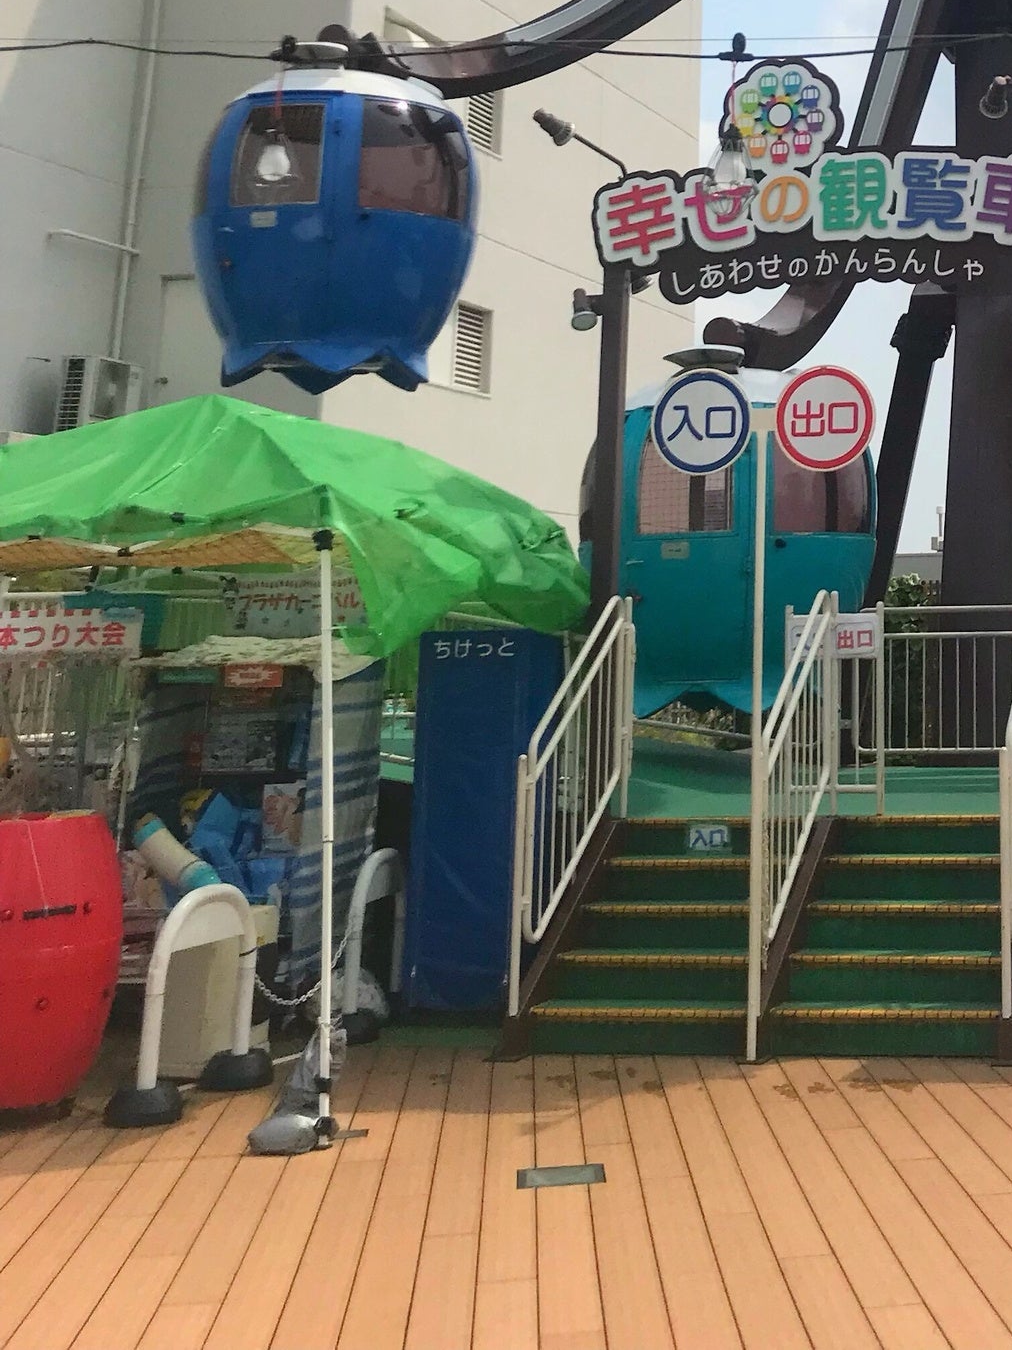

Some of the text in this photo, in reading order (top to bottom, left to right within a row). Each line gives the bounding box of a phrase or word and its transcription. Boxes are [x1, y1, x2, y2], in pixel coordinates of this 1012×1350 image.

[670, 248, 986, 297] しあわせのかんらんしゃ
[667, 405, 737, 441] 入口
[791, 400, 858, 437] 出口
[433, 637, 515, 659] ちけっと
[837, 630, 873, 649] 出口
[691, 829, 726, 847] 入口
